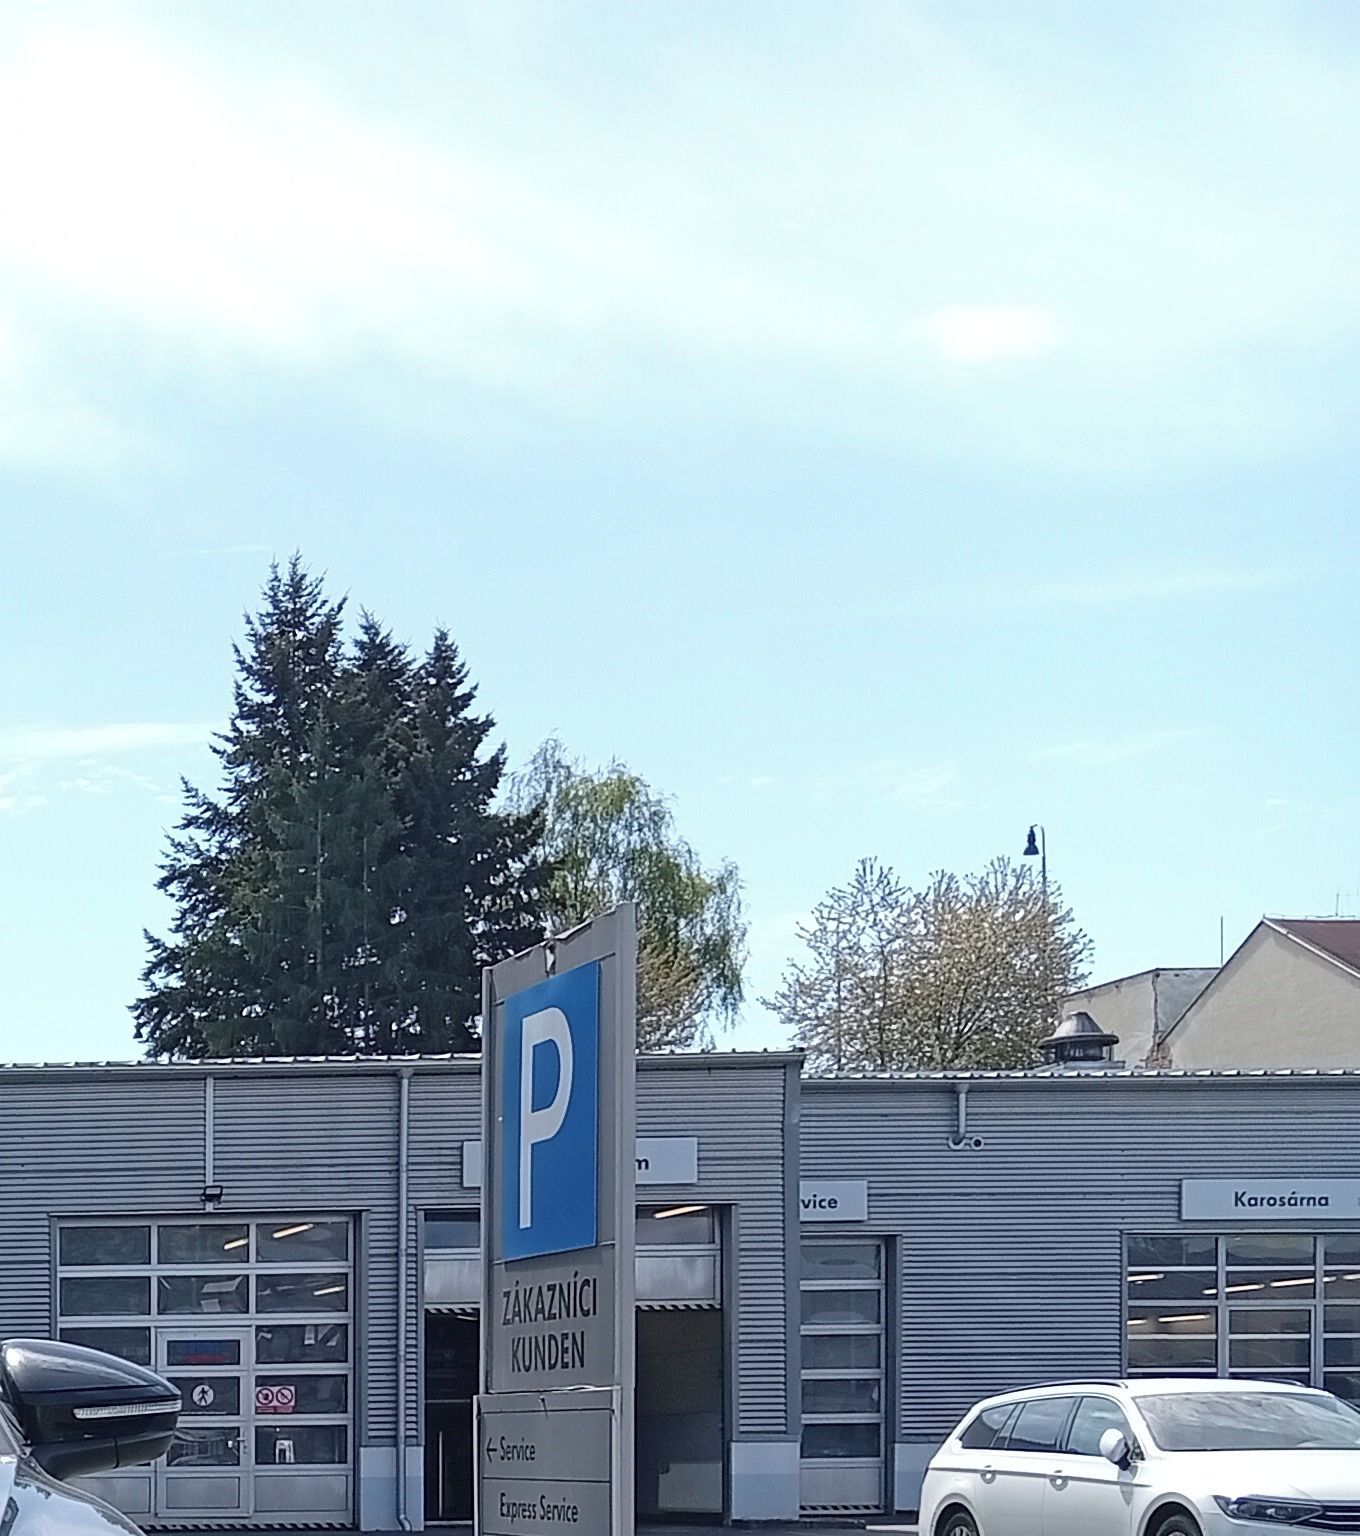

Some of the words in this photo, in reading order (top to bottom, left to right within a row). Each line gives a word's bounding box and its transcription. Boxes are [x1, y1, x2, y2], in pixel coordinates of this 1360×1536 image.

[518, 1006, 574, 1230] P
[1233, 1190, 1330, 1208] Karosárna
[502, 1269, 598, 1327] ZÁKAZNÍCI
[511, 1330, 585, 1373] KUNDEN
[499, 1436, 536, 1461] Service
[499, 1492, 537, 1524] Express
[539, 1494, 579, 1523] Service
